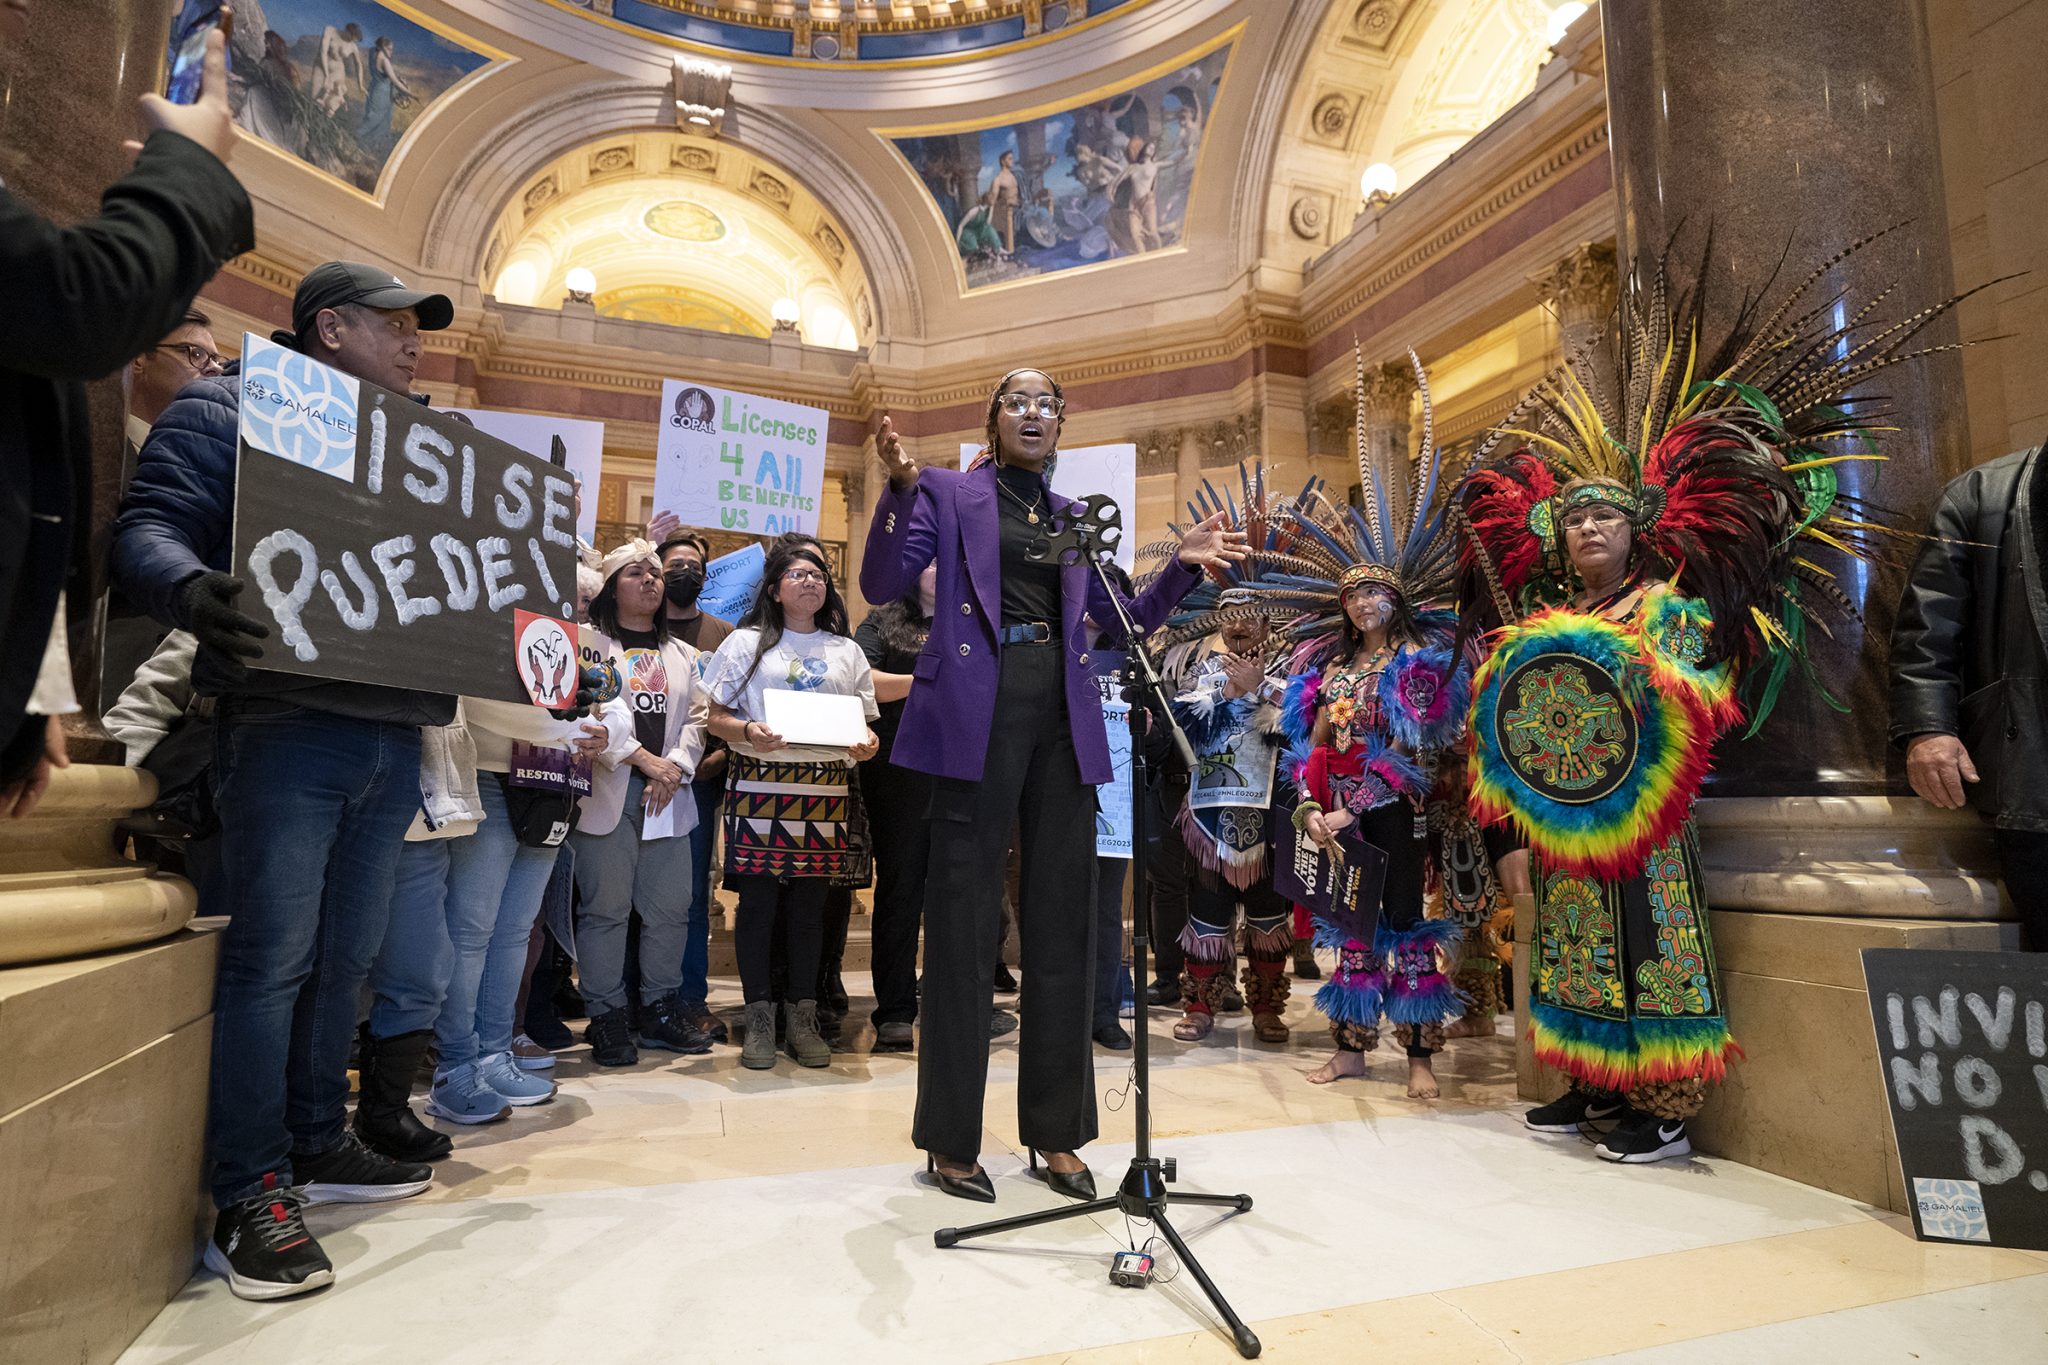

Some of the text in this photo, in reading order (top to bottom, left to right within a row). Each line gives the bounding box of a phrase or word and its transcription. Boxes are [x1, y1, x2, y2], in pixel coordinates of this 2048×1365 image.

[269, 392, 357, 436] GAMALIEL
[670, 414, 716, 435] COPAL
[721, 395, 818, 446] Licenses
[719, 441, 745, 476] 4
[494, 462, 575, 548] SE
[717, 479, 814, 512] BENEFITS
[720, 506, 750, 529] US
[632, 692, 668, 713] OP
[1300, 850, 1309, 876] THE
[1302, 853, 1319, 896] VOTE
[1344, 865, 1355, 906] Restore
[1349, 893, 1358, 912] the
[1890, 1051, 2003, 1111] NO
[1931, 1202, 1985, 1215] GAMALIEL
